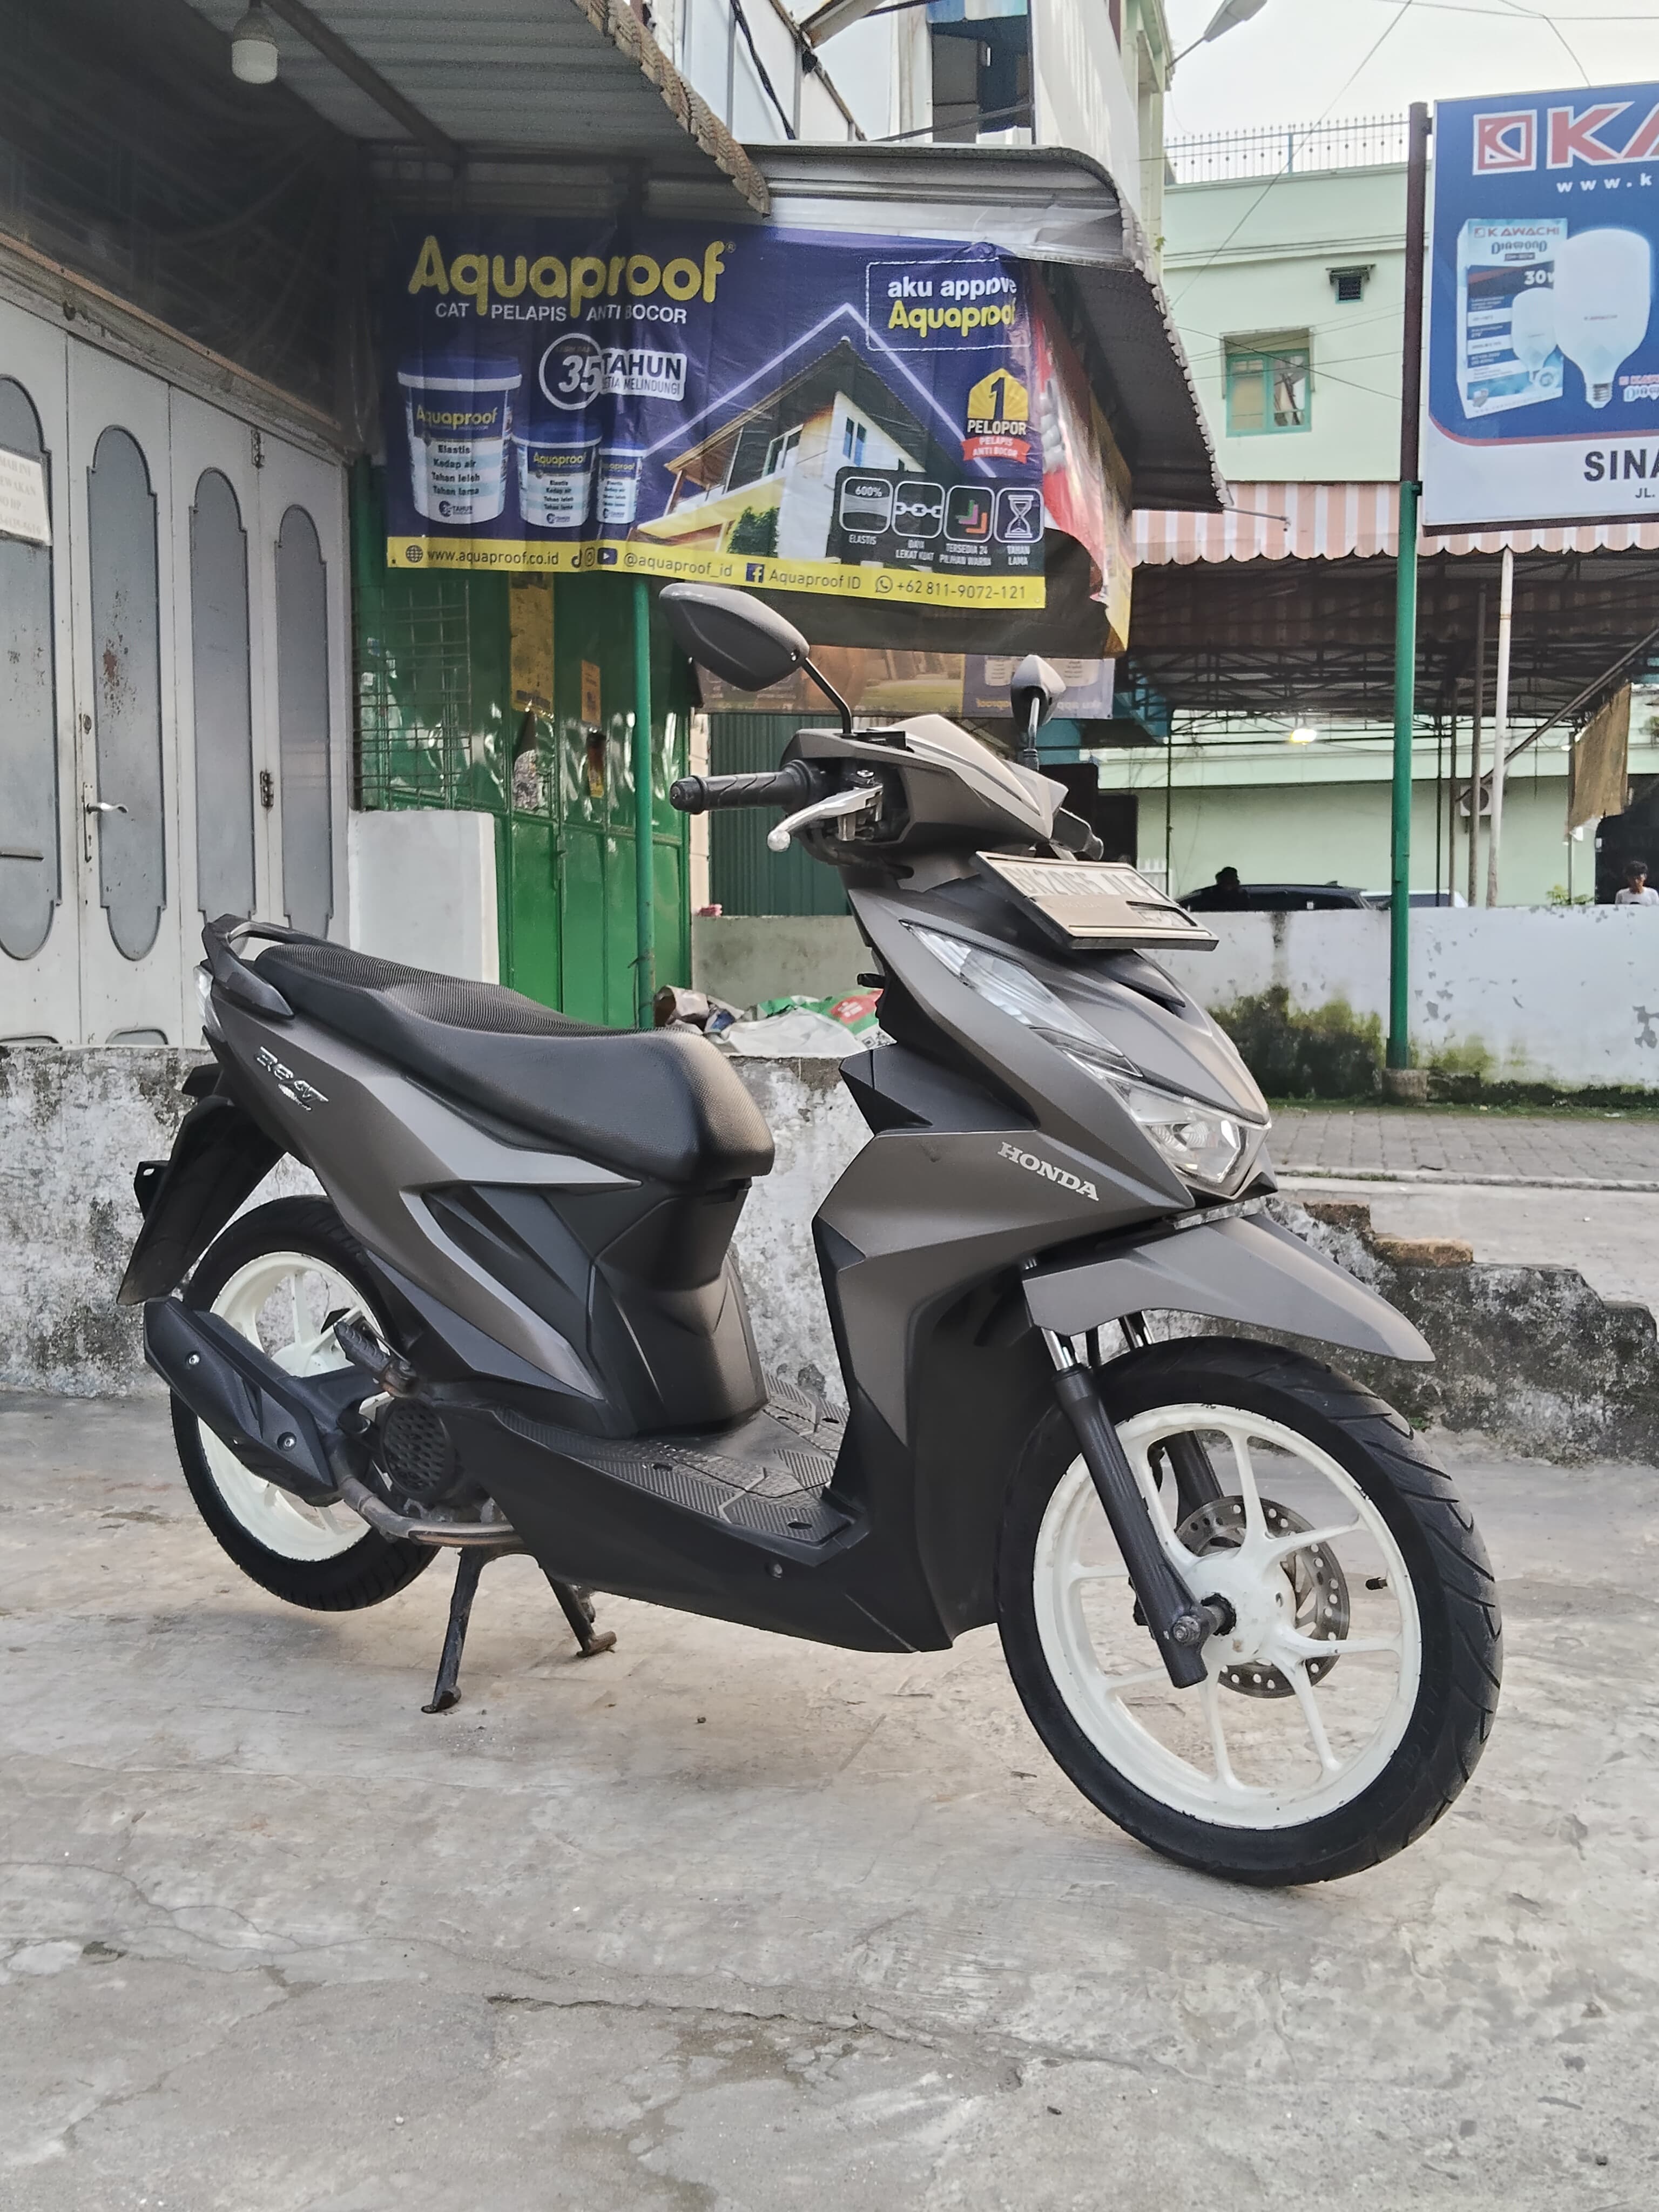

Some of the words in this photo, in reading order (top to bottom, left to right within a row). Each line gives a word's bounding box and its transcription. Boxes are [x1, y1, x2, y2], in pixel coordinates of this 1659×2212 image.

[1488, 226, 1560, 237] KAWACHI
[408, 235, 725, 318] Aquaproof
[888, 276, 933, 298] aku
[435, 302, 470, 318] CAT
[491, 305, 567, 321] PELAPIS
[586, 304, 622, 321] ANTI
[625, 304, 687, 324] BOCOR
[888, 299, 1016, 338] Aquaproof
[558, 355, 602, 393] 35
[602, 353, 681, 380] TAHUN
[624, 378, 680, 395] MELINDUNGI
[988, 376, 1006, 421] 1
[416, 404, 498, 430] Aquaproof
[967, 420, 1027, 435] PELOPOR
[437, 444, 471, 454] Elastis
[979, 436, 1014, 447] PELAPIS
[973, 447, 992, 457] ANTI
[433, 458, 461, 469] Kedap
[464, 460, 476, 468] air
[431, 471, 455, 482] Tahan
[457, 472, 480, 482] leleh
[855, 485, 883, 497] 600%
[1635, 488, 1656, 498] JL.
[849, 534, 877, 545] ELASTIS
[1008, 556, 1028, 566] LAMA
[428, 550, 559, 565] www.aquaproof.co.id
[624, 552, 733, 578] @aquaproof_id
[769, 569, 844, 588] Aquaproof
[848, 576, 861, 589] ID
[897, 579, 922, 594] +62
[927, 582, 1025, 599] 811-9072-121
[997, 1142, 1100, 1201] HONDA
